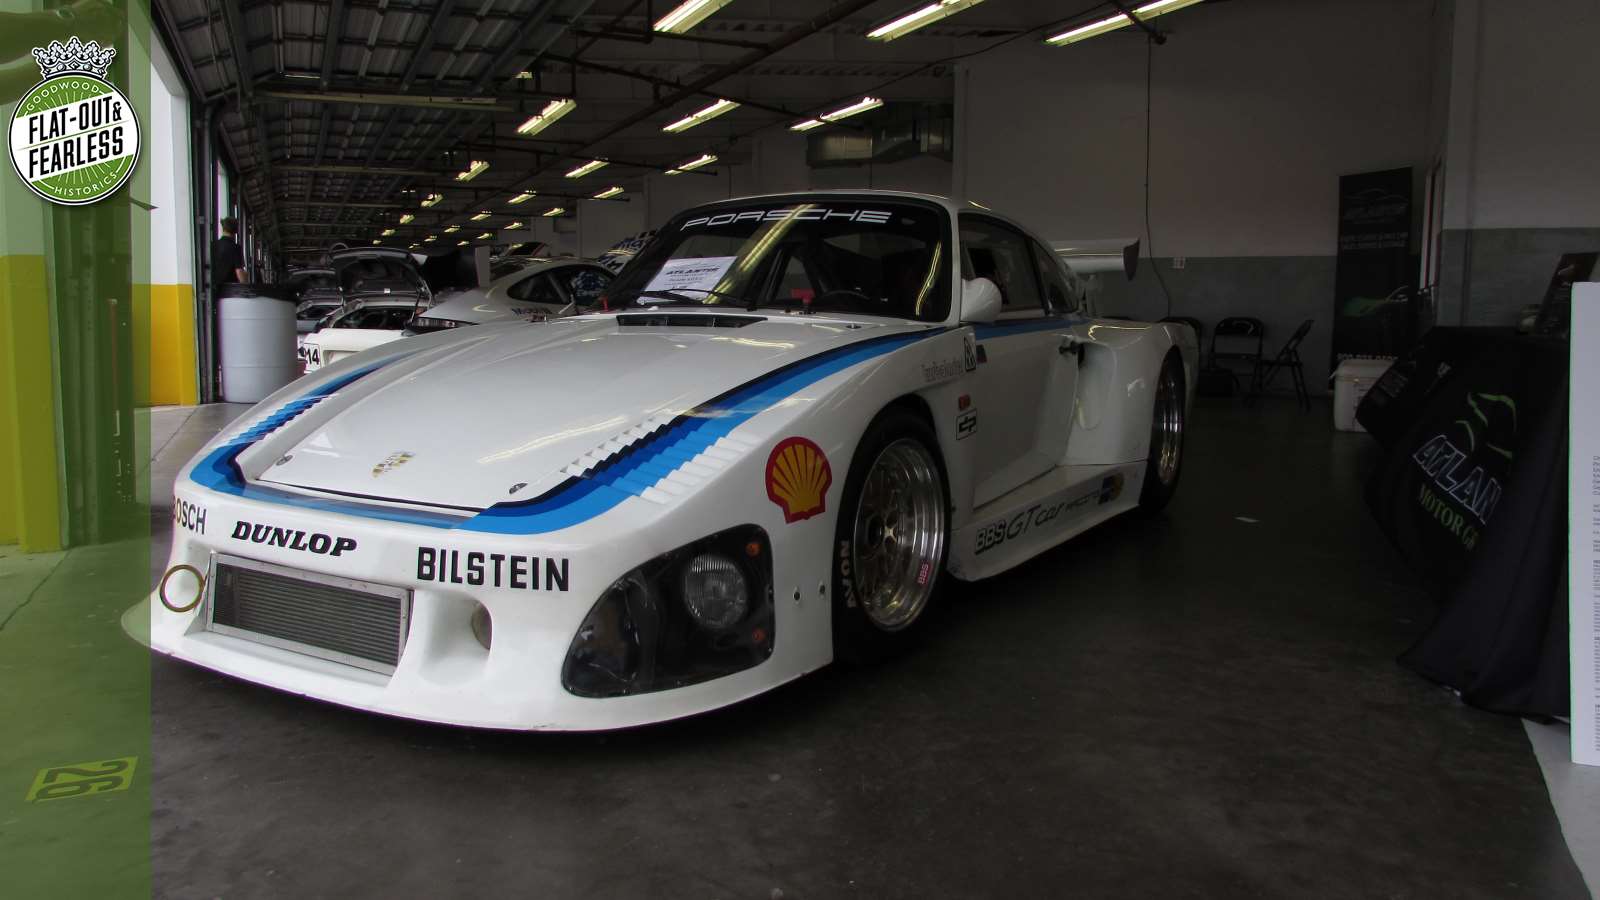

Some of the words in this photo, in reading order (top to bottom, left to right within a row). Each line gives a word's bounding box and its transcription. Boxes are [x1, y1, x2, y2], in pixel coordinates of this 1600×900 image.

[680, 208, 892, 231] PORSCHE
[306, 348, 320, 365] 14
[231, 520, 357, 557] DUNLOP
[417, 546, 570, 592] BILSTEIN
[840, 539, 857, 608] AVON
[917, 563, 930, 585] BBS
[35, 760, 129, 800] 26
